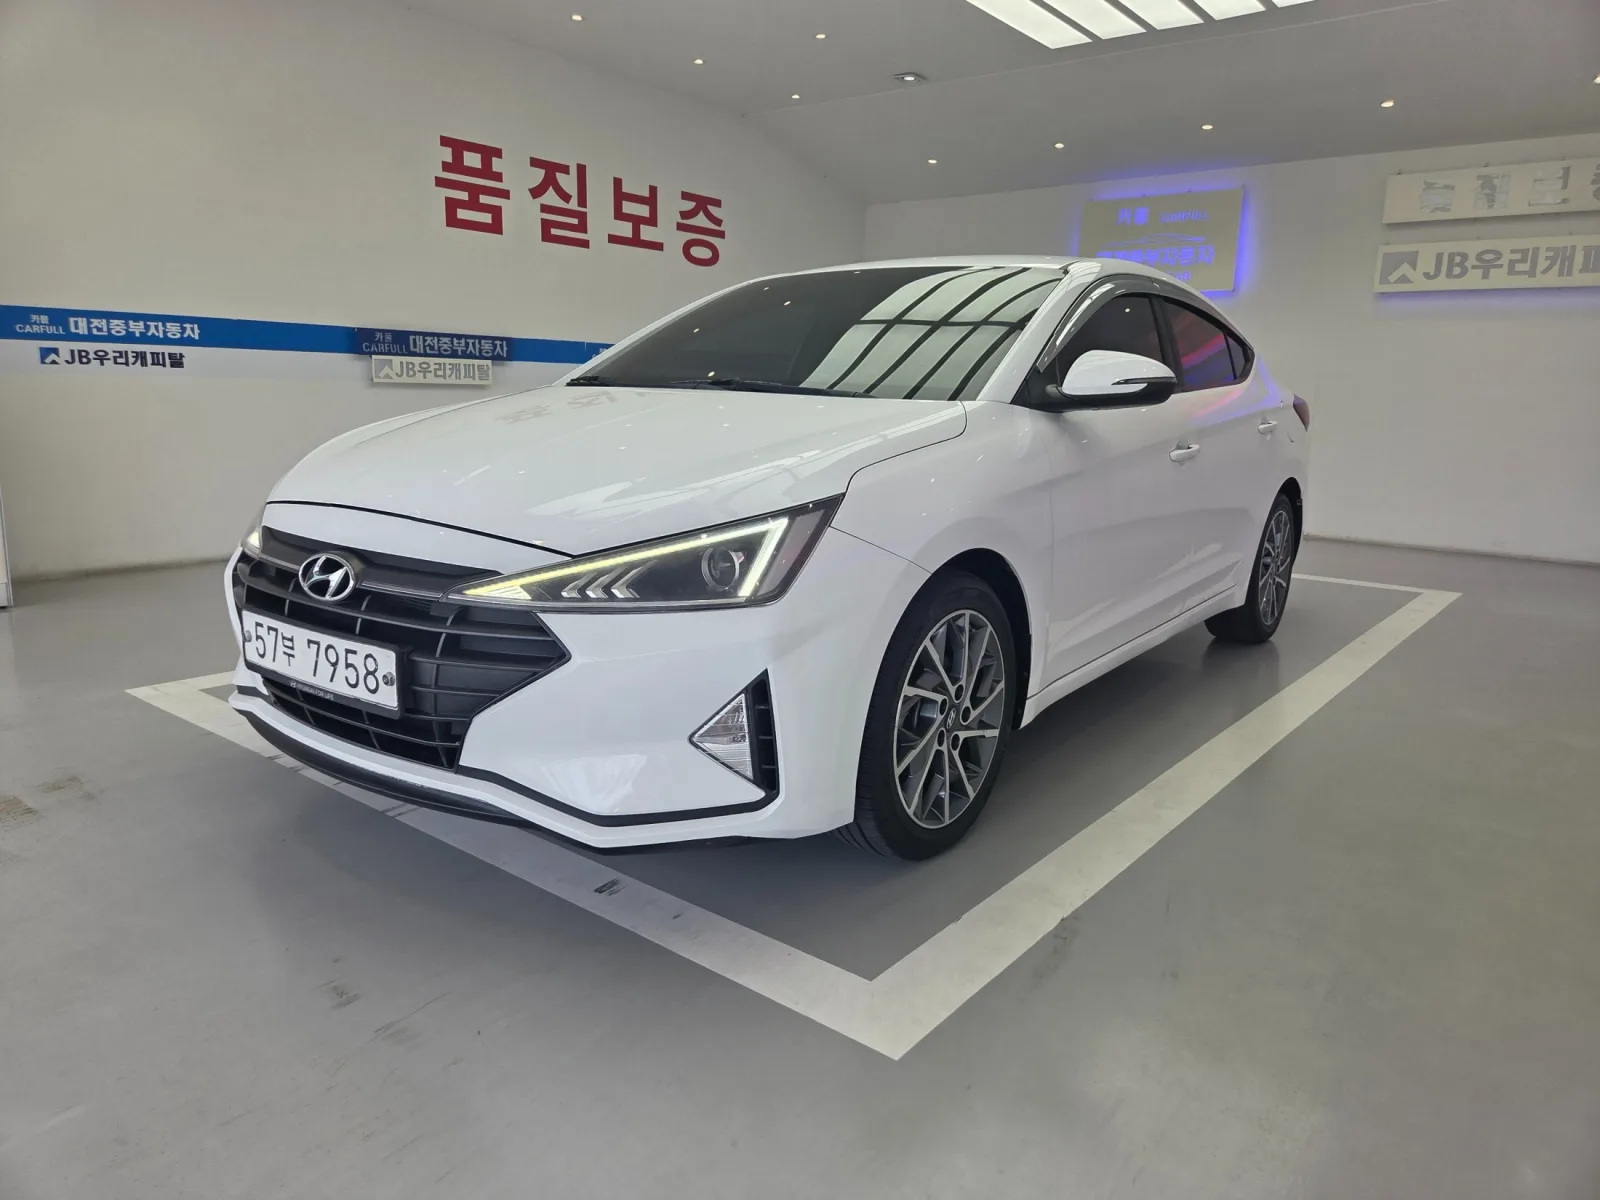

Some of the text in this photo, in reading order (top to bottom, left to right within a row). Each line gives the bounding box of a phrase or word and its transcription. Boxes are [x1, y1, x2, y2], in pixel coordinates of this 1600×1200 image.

[434, 134, 726, 267] 품질보증
[15, 324, 66, 335] CARFULL
[68, 317, 200, 340] 대전중부자동차
[362, 342, 408, 355] CARFULL
[409, 335, 508, 358] 대전중부자동차
[64, 349, 185, 369] JB우리캐피탈
[394, 361, 491, 381] JB우리캐피탈
[254, 621, 380, 695] 57부 7958
